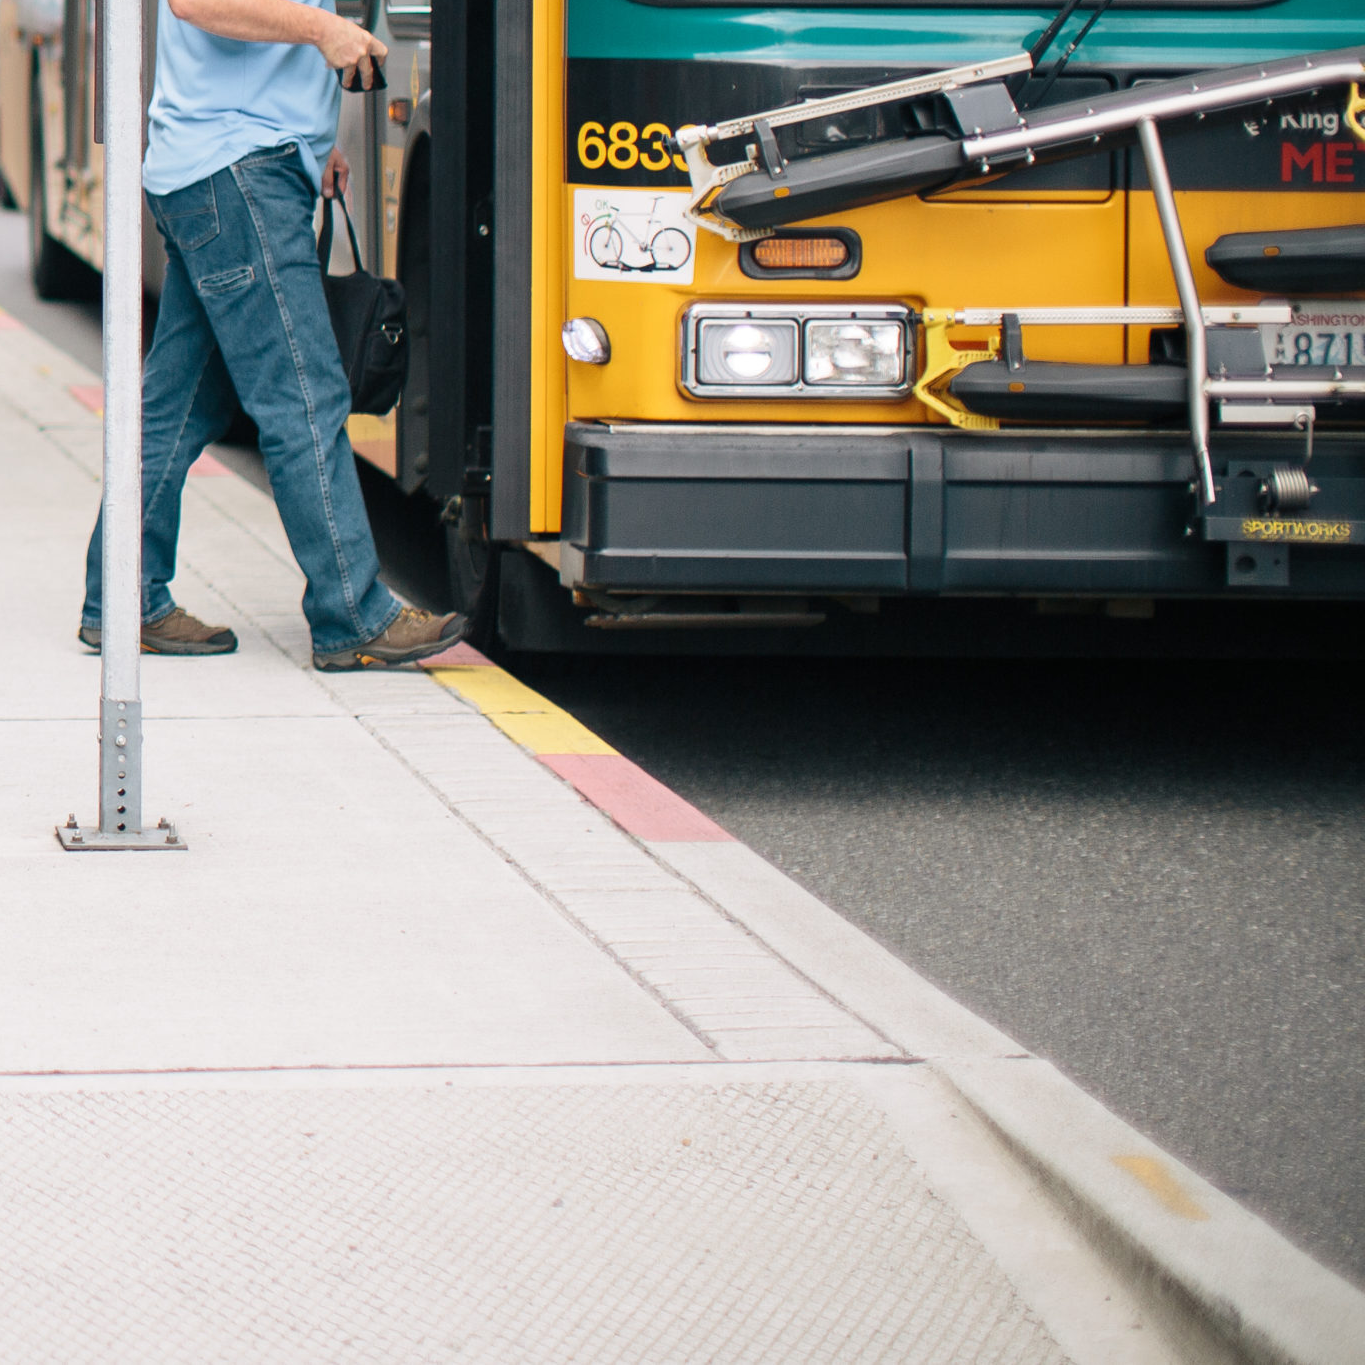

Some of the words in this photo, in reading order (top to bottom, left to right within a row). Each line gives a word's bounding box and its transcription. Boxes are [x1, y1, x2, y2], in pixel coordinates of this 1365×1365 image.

[1281, 112, 1339, 136] King
[1294, 332, 1365, 365] 871
[1242, 519, 1351, 536] SPORTWORKS
